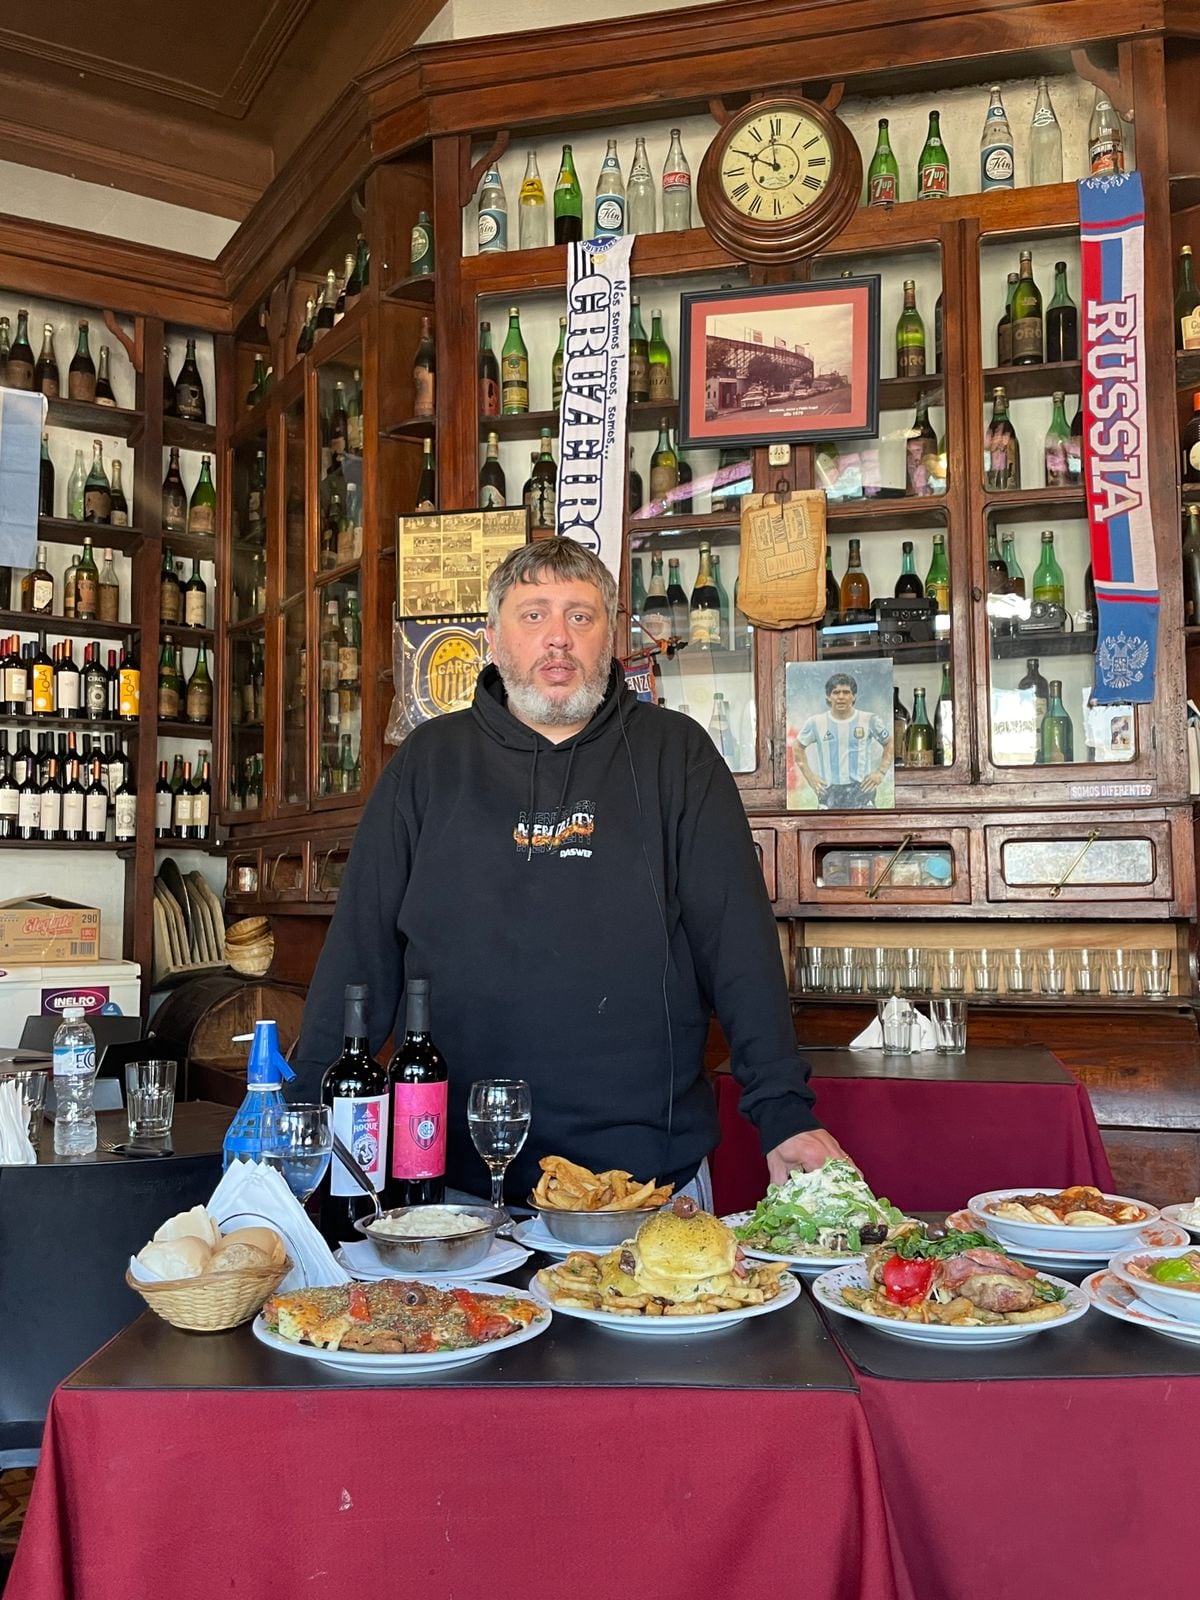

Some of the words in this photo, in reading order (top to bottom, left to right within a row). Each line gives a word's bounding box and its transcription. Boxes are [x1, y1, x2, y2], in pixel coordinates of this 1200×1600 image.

[612, 280, 627, 307] Nós
[610, 312, 621, 350] somos
[605, 354, 626, 401] loucos,
[1087, 294, 1143, 523] RUSSIA
[1071, 785, 1100, 800] SOMOS
[1101, 784, 1153, 798] DIFERENTES
[81, 914, 98, 924] 290
[54, 996, 96, 1008] INELRO
[353, 1122, 379, 1133] ROQUE
